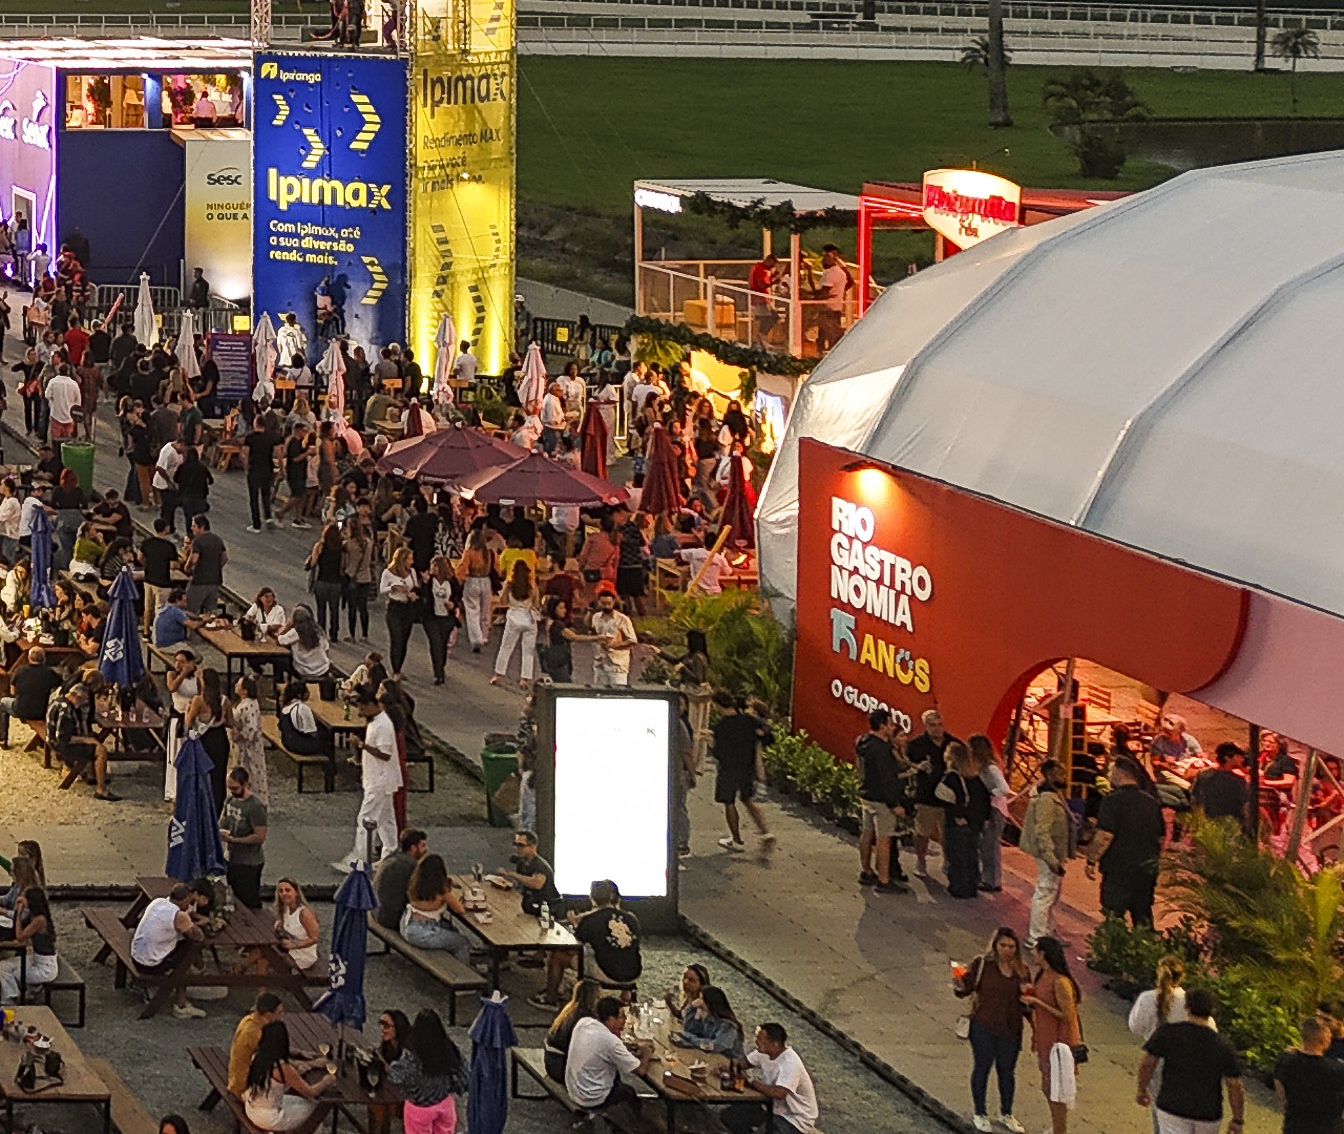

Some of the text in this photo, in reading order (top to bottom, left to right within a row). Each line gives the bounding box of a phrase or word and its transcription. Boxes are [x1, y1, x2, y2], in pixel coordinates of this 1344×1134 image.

[280, 70, 321, 83] Ipiranga
[422, 68, 506, 119] Ipimax
[207, 167, 242, 186] Sesc
[267, 168, 392, 211] Ipimax
[269, 220, 295, 233] Com
[297, 222, 338, 239] Ipimax,
[269, 236, 355, 252] a sua diversão
[306, 252, 338, 265] mais.
[831, 496, 874, 543] RIO
[830, 532, 932, 602] GASTRO
[830, 564, 913, 633] NOMIA
[830, 607, 931, 693] 15 ANOS
[831, 679, 843, 698] O
